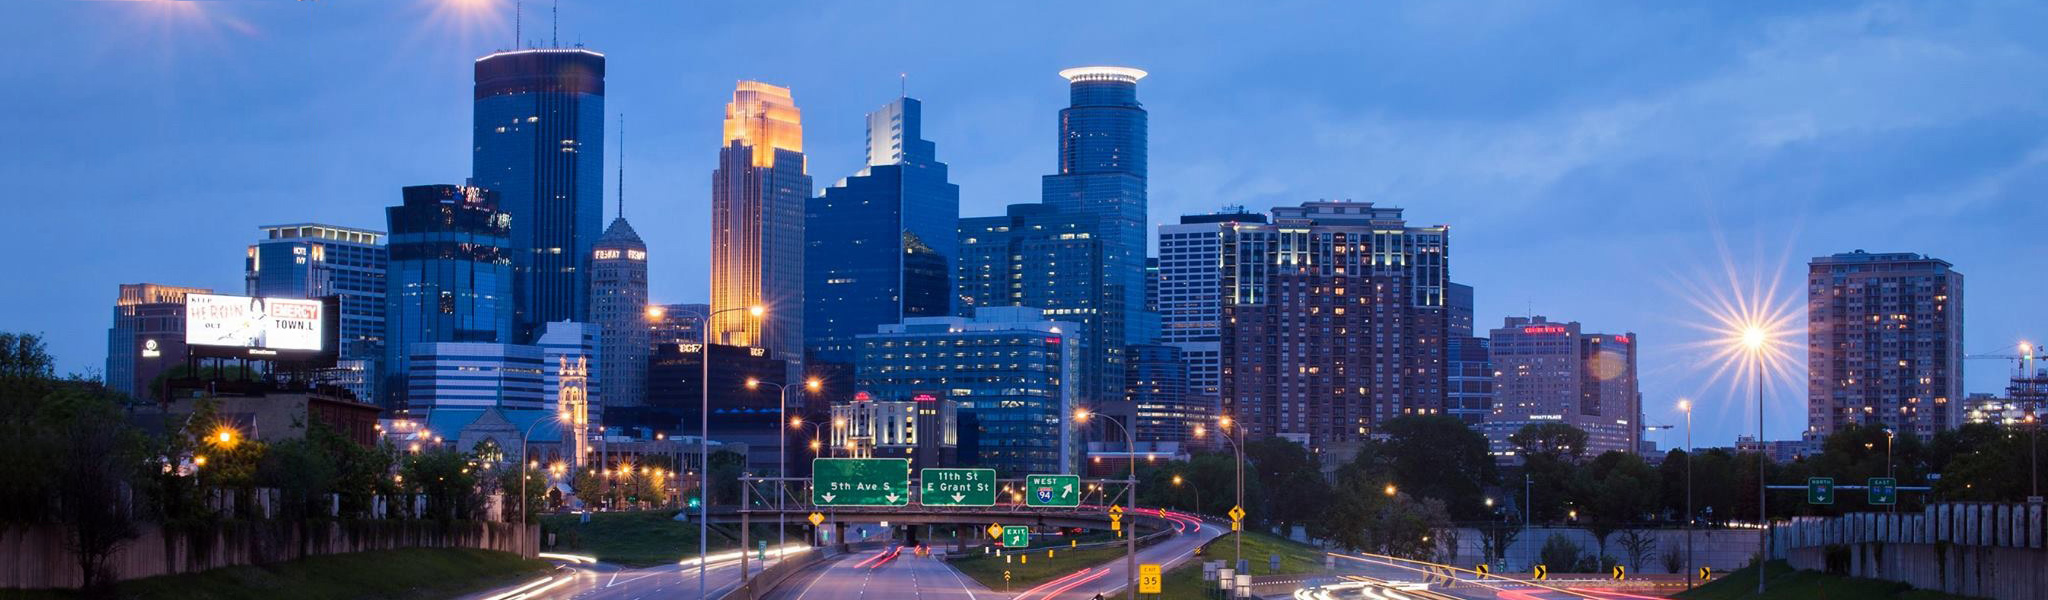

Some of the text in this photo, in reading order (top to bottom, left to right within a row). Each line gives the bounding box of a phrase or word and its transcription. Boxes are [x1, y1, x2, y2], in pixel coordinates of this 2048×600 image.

[938, 472, 978, 480] 11th St
[831, 482, 890, 490] 5th Ave S
[927, 482, 989, 491] E Grant St
[1039, 491, 1051, 499] 94
[1144, 576, 1157, 585] 35
